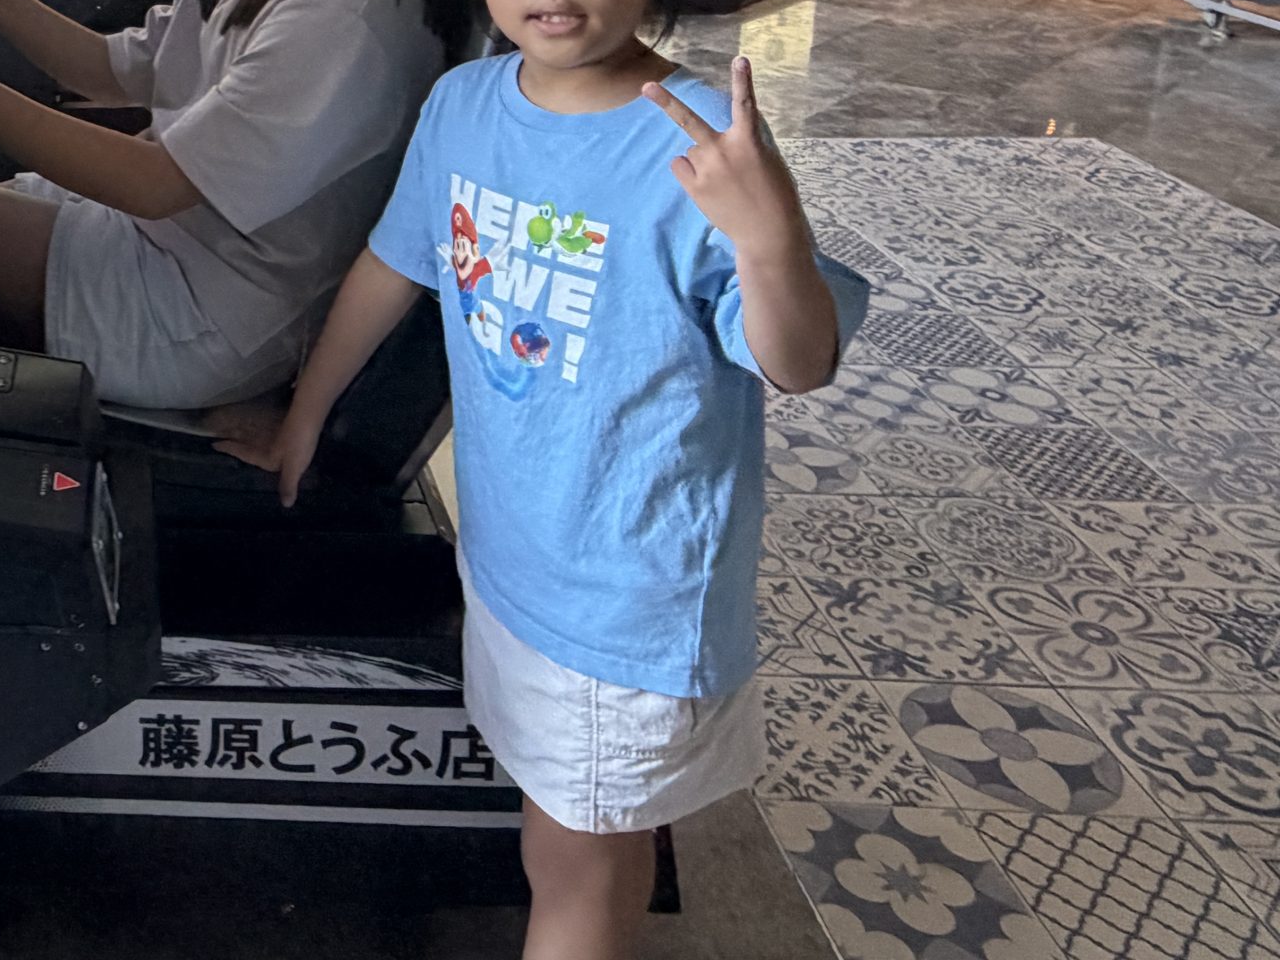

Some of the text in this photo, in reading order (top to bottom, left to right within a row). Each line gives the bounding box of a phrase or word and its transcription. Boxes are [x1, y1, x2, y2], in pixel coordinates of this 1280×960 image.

[493, 256, 598, 329] WE
[138, 713, 495, 782] 藤原とうふ店
